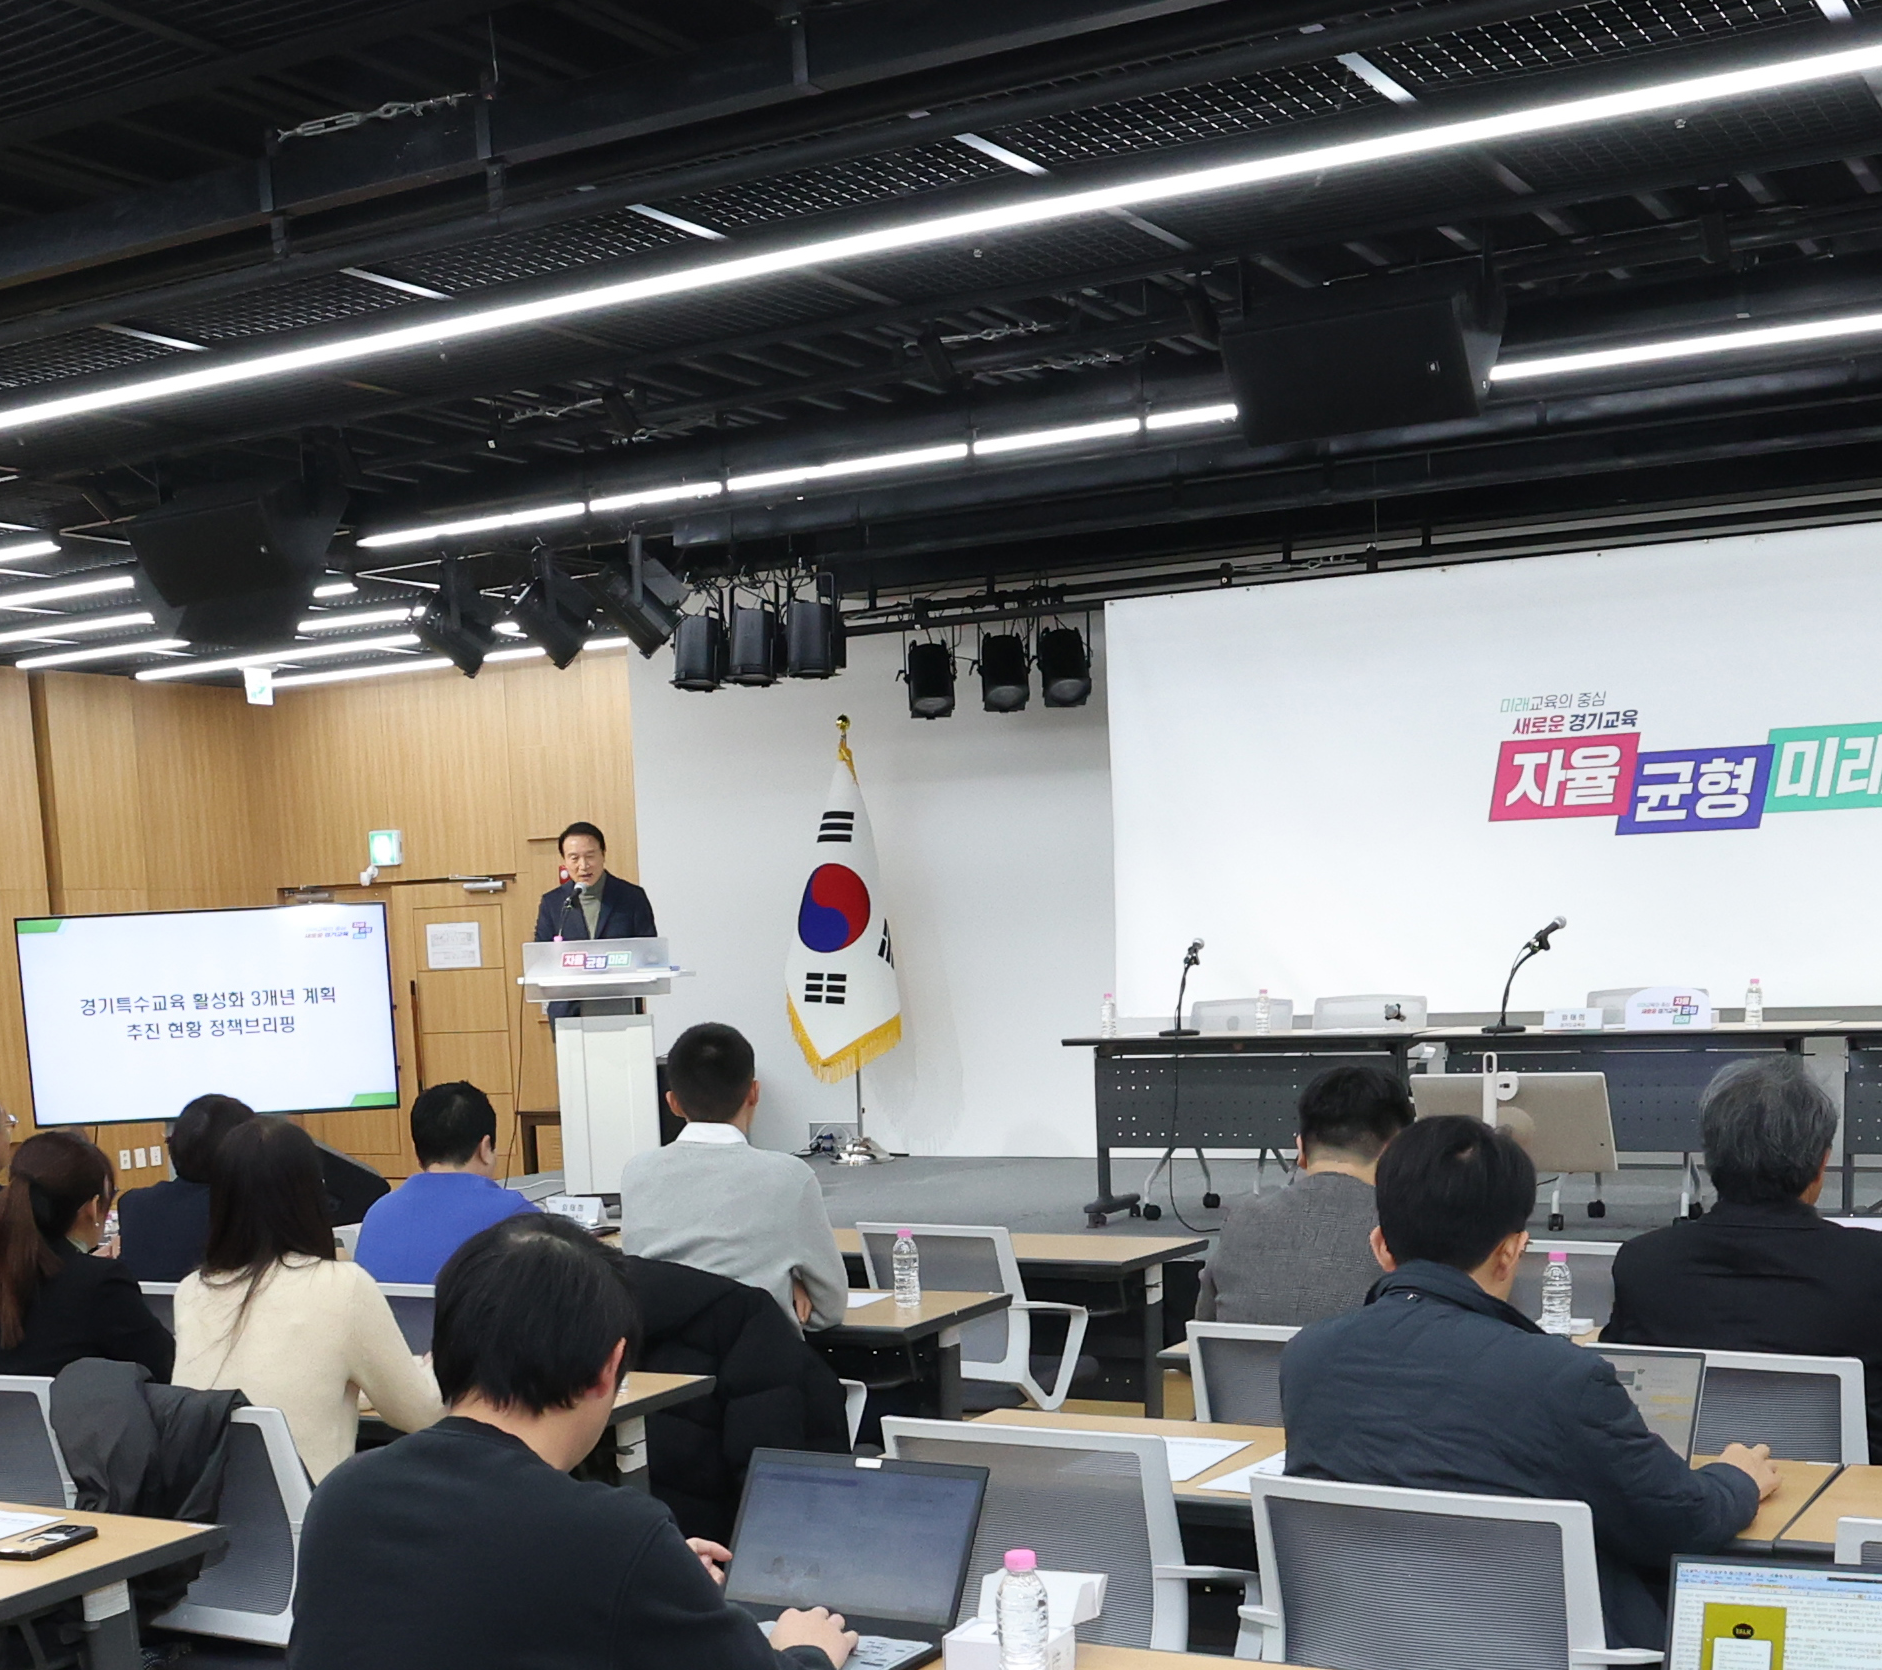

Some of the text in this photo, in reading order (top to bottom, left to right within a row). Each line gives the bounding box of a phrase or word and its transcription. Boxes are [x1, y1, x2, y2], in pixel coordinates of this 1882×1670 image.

[1500, 690, 1607, 713] 미래교육의 중심
[1512, 709, 1638, 735] 새로운 경기교육
[1505, 745, 1622, 808] 자율
[1633, 757, 1757, 822] 균형
[80, 986, 337, 1016] 경기특수교육 활성화 3개년 계획
[126, 1015, 296, 1041] 추진 현황 정책브리핑
